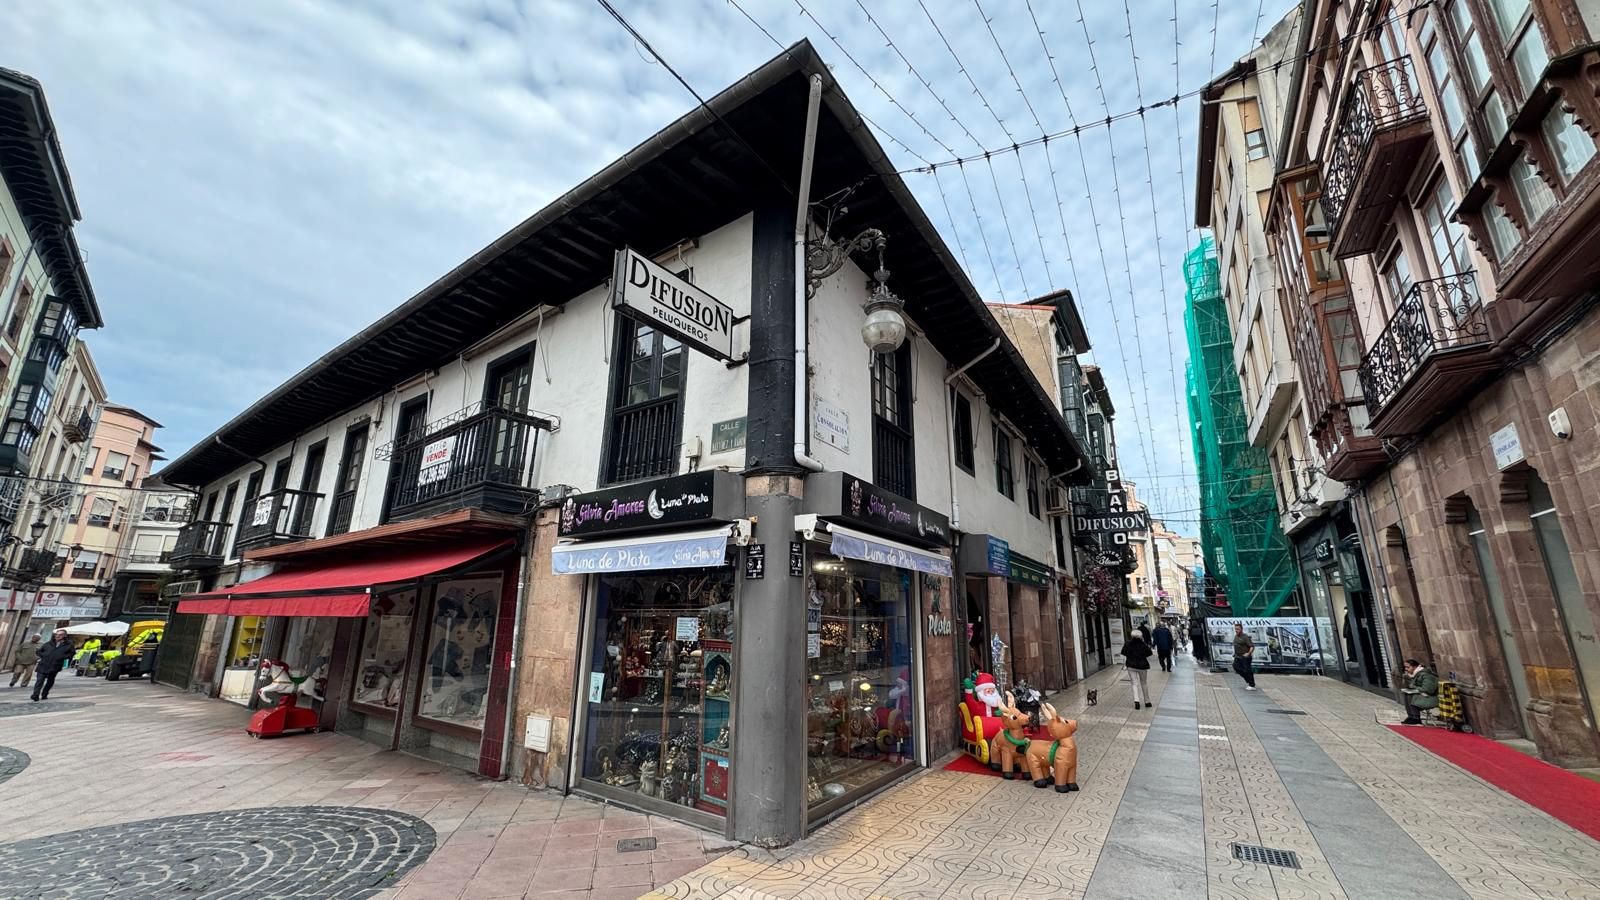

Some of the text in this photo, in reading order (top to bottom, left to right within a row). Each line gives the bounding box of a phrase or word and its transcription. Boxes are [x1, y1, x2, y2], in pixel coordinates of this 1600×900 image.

[629, 254, 729, 336] DIFUSION
[653, 306, 708, 341] PELUQUEROS
[720, 421, 740, 431] CALLE
[425, 448, 449, 463] VENDE
[576, 498, 645, 526] Silvia Amores
[661, 497, 682, 509] Luna
[688, 493, 709, 505] Plata
[1077, 512, 1145, 531] DIFUSION
[568, 549, 651, 570] Luna de Plata
[864, 541, 886, 563] Luna
[887, 548, 897, 566] de
[899, 549, 918, 570] Plata
[928, 612, 951, 636] Plata
